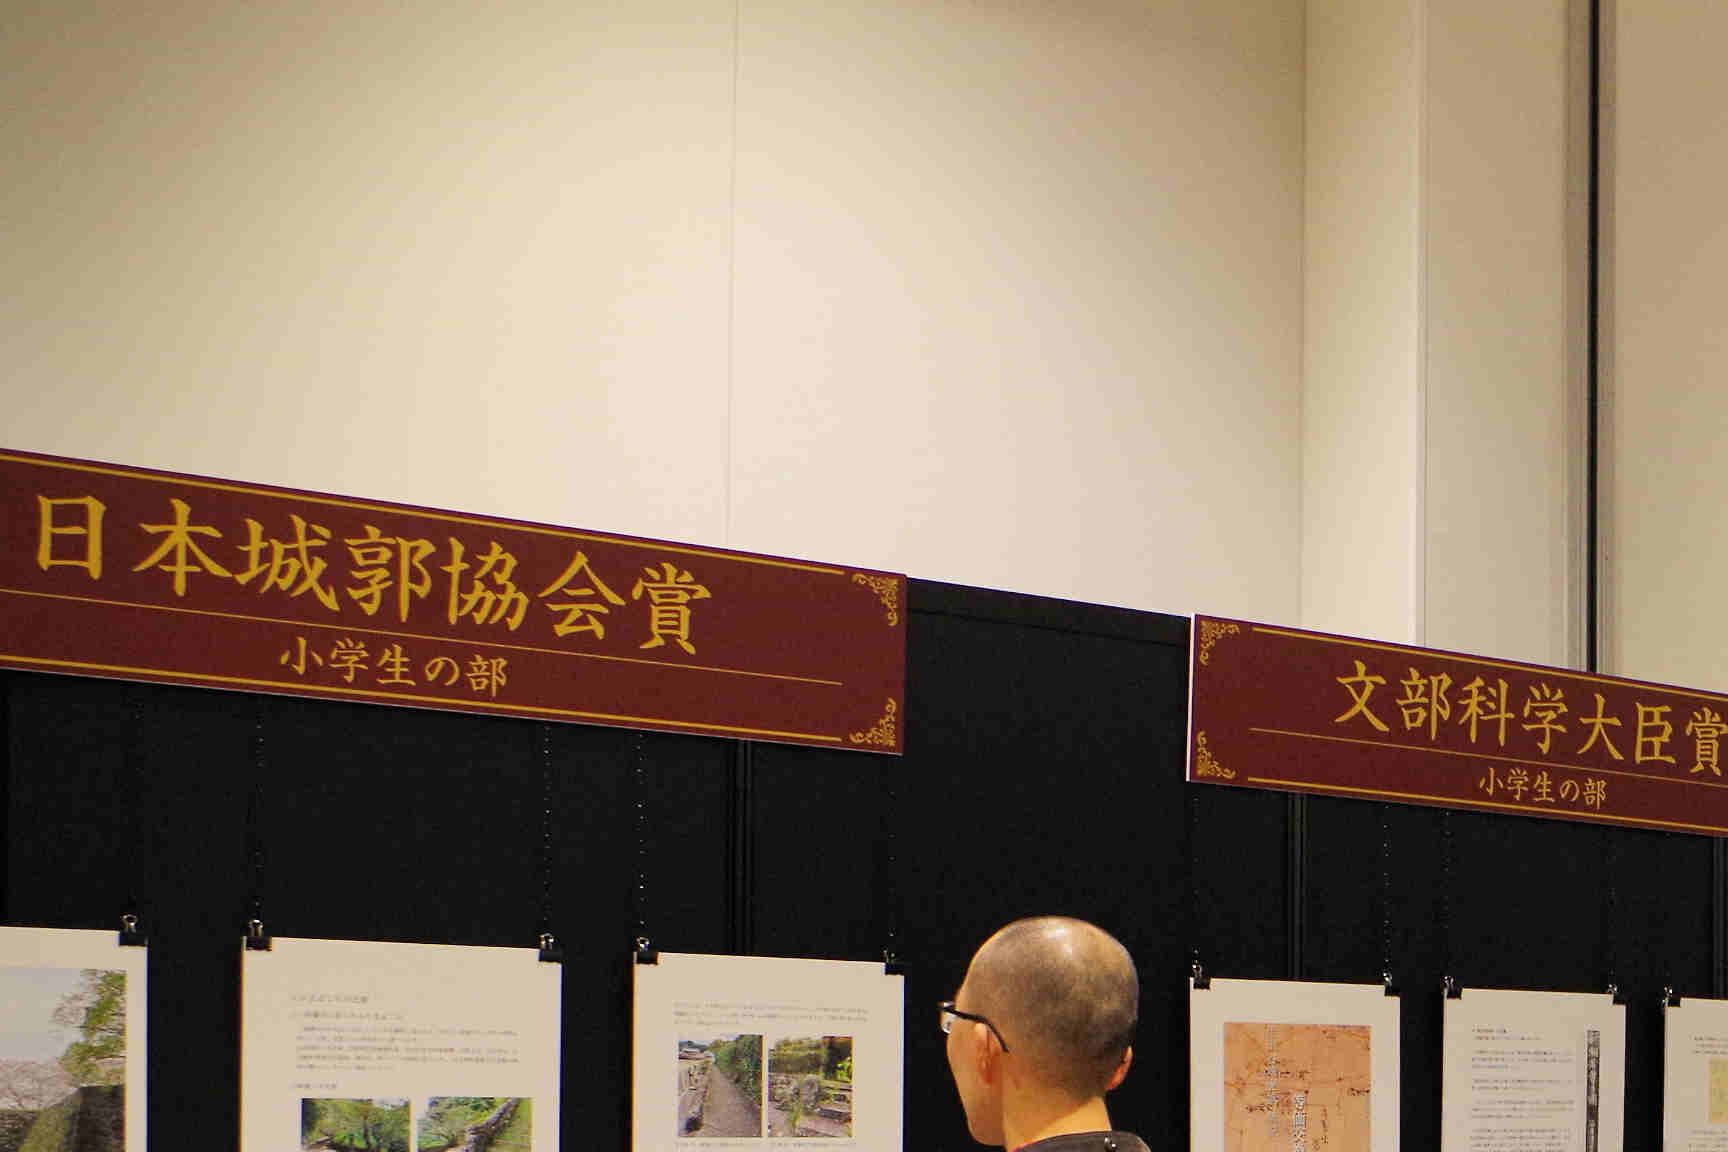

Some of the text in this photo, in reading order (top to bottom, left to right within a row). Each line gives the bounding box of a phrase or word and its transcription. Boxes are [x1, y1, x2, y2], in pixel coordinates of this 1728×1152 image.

[36, 495, 712, 655] 日本城郭協会賞
[280, 637, 508, 697] 小学生の部
[1479, 767, 1607, 809] 小学生の部
